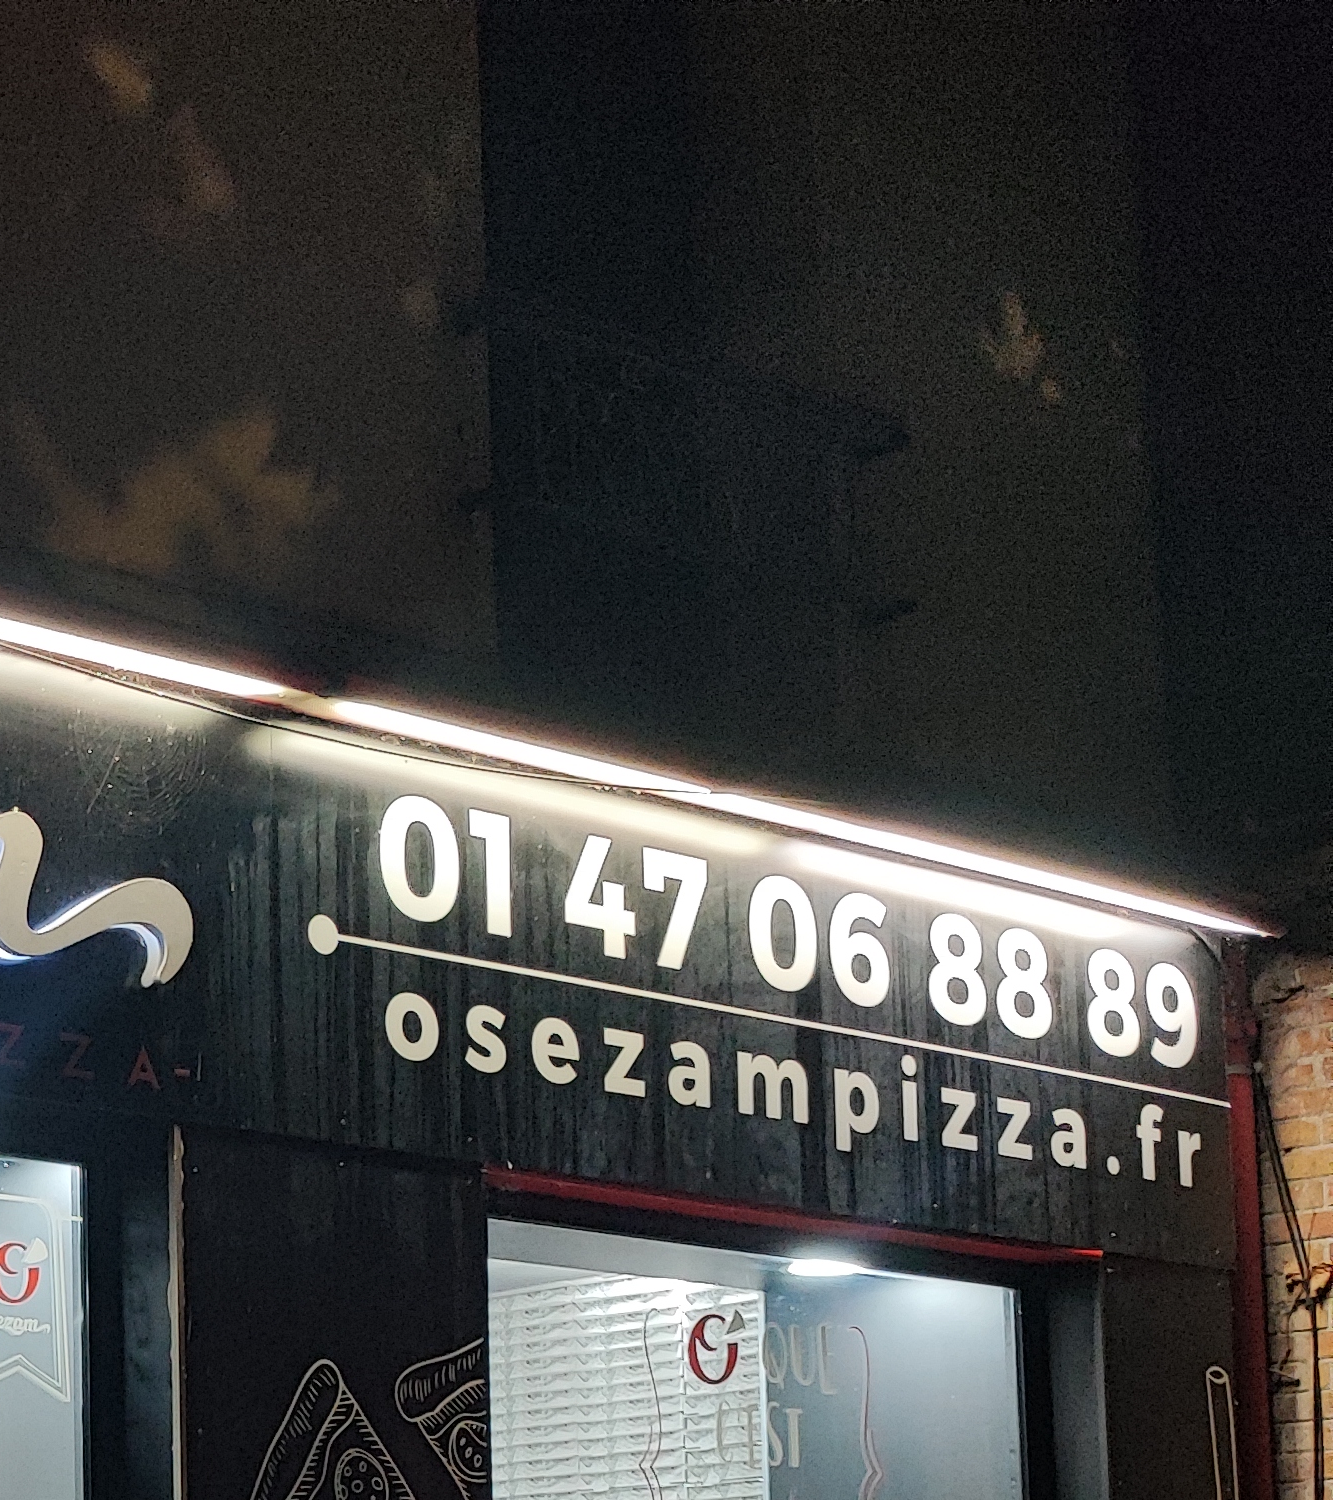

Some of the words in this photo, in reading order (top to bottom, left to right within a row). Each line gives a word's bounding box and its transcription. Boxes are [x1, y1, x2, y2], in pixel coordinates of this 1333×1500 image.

[378, 795, 513, 937] 01
[565, 835, 708, 970] 47
[747, 876, 889, 1008] 06
[929, 913, 1055, 1040] 88
[1086, 948, 1199, 1070] 89
[385, 991, 1202, 1188] osezampizza.fr
[763, 1322, 838, 1395] QUE
